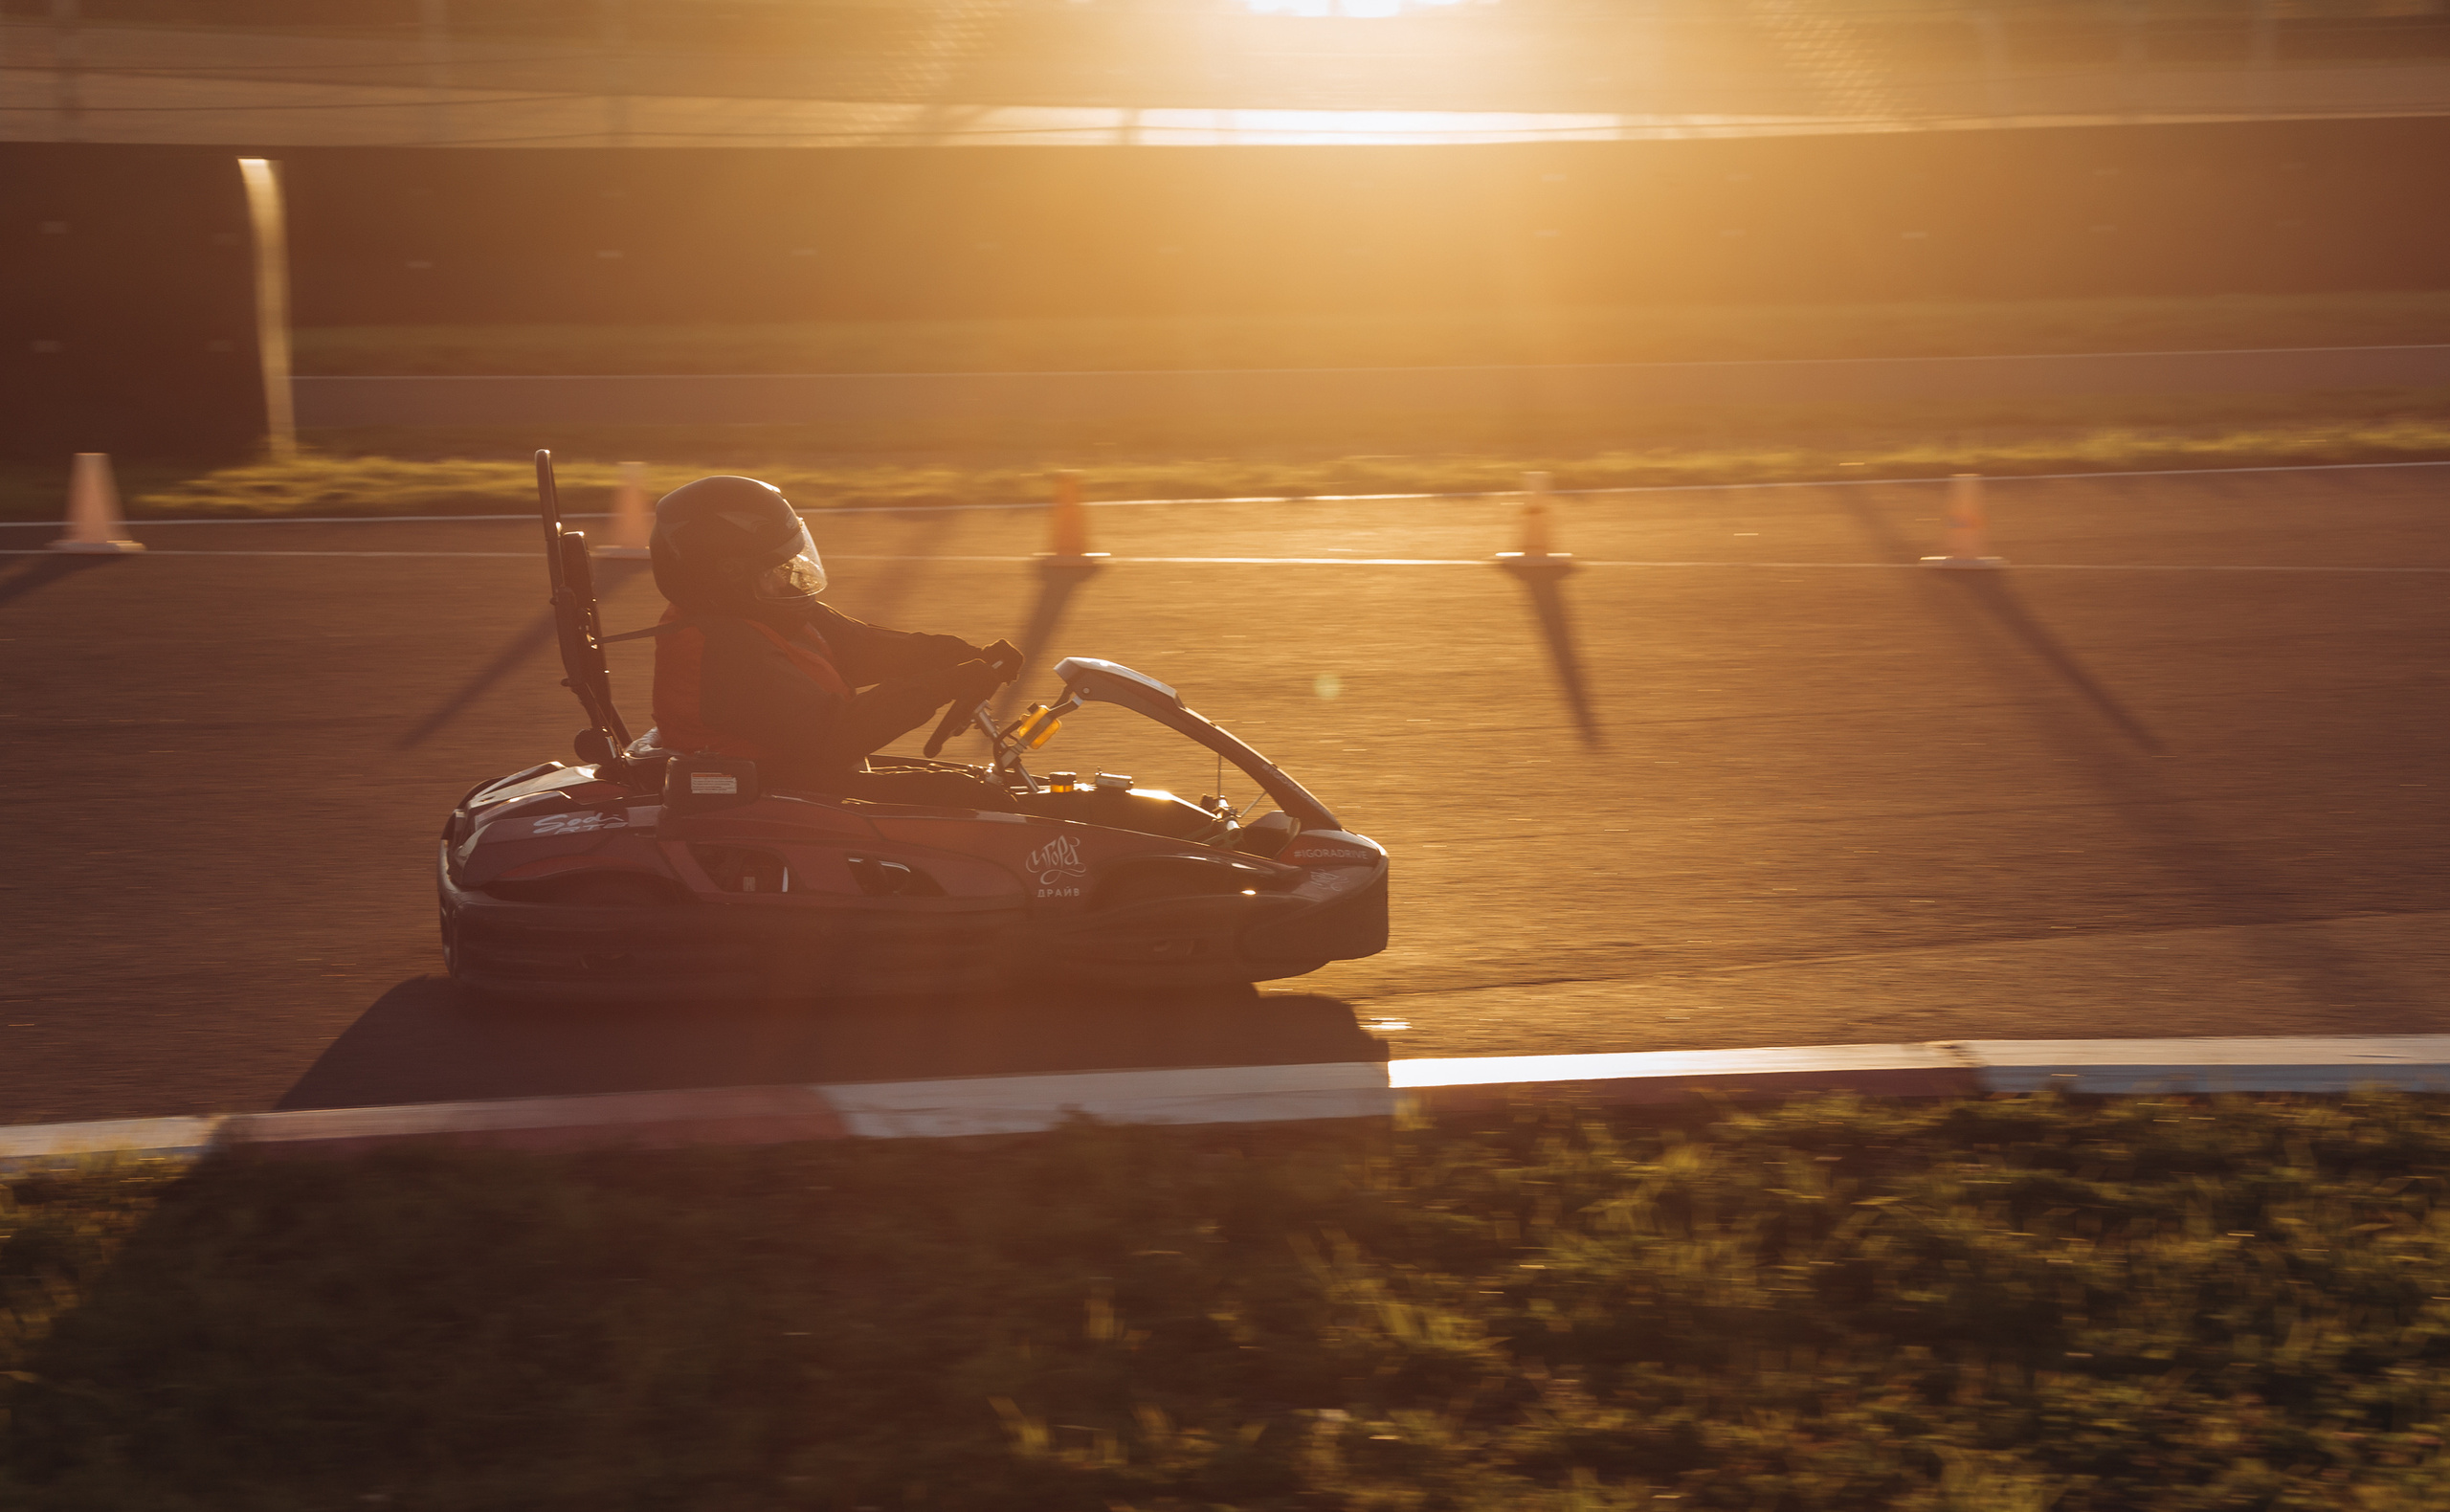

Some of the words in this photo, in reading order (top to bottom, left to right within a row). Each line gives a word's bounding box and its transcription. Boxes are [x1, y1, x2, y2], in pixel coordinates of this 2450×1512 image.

[533, 812, 624, 834] Sodi
[1293, 848, 1369, 859] #IGORADRIVE
[1036, 886, 1080, 898] ДРАЙВ
